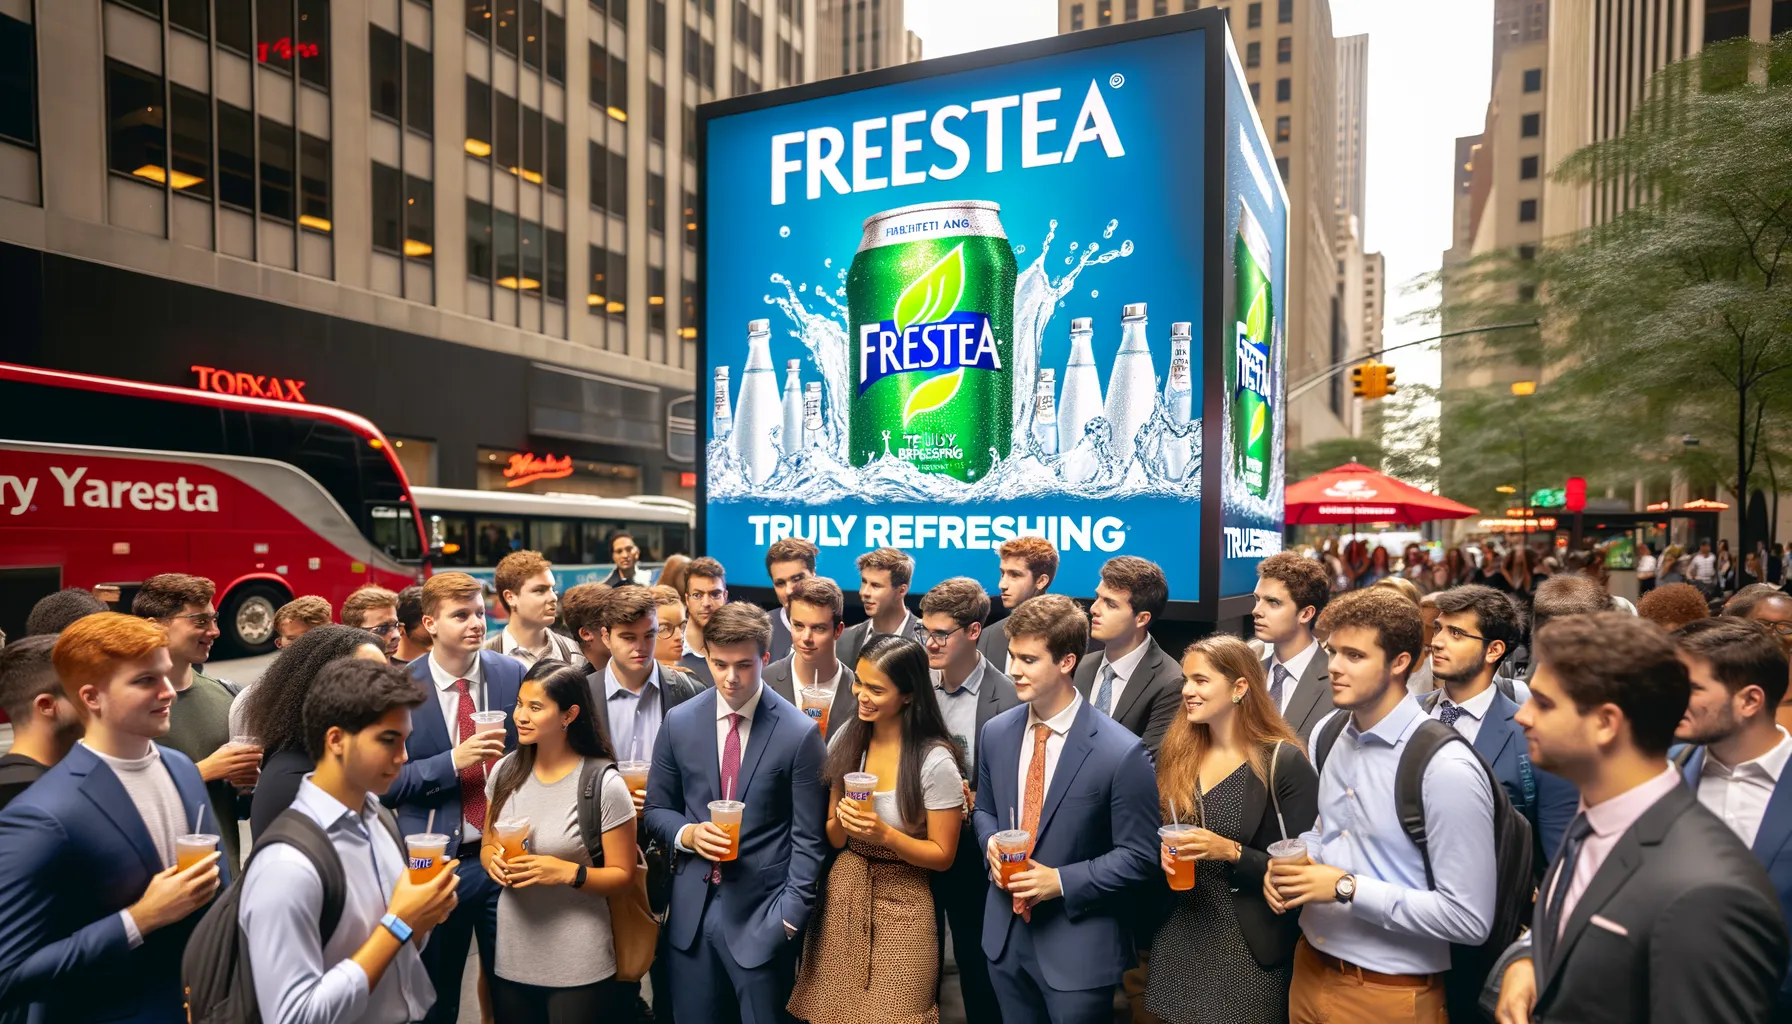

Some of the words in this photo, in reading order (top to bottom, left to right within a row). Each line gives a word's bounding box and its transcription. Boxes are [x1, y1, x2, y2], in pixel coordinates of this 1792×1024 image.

[771, 78, 1126, 205] FREESTEA
[943, 219, 970, 231] ANG
[860, 317, 1002, 384] FRESTEA
[49, 467, 219, 512] Yaresta
[748, 515, 857, 547] TRULY
[865, 516, 1126, 552] REFRESHING
